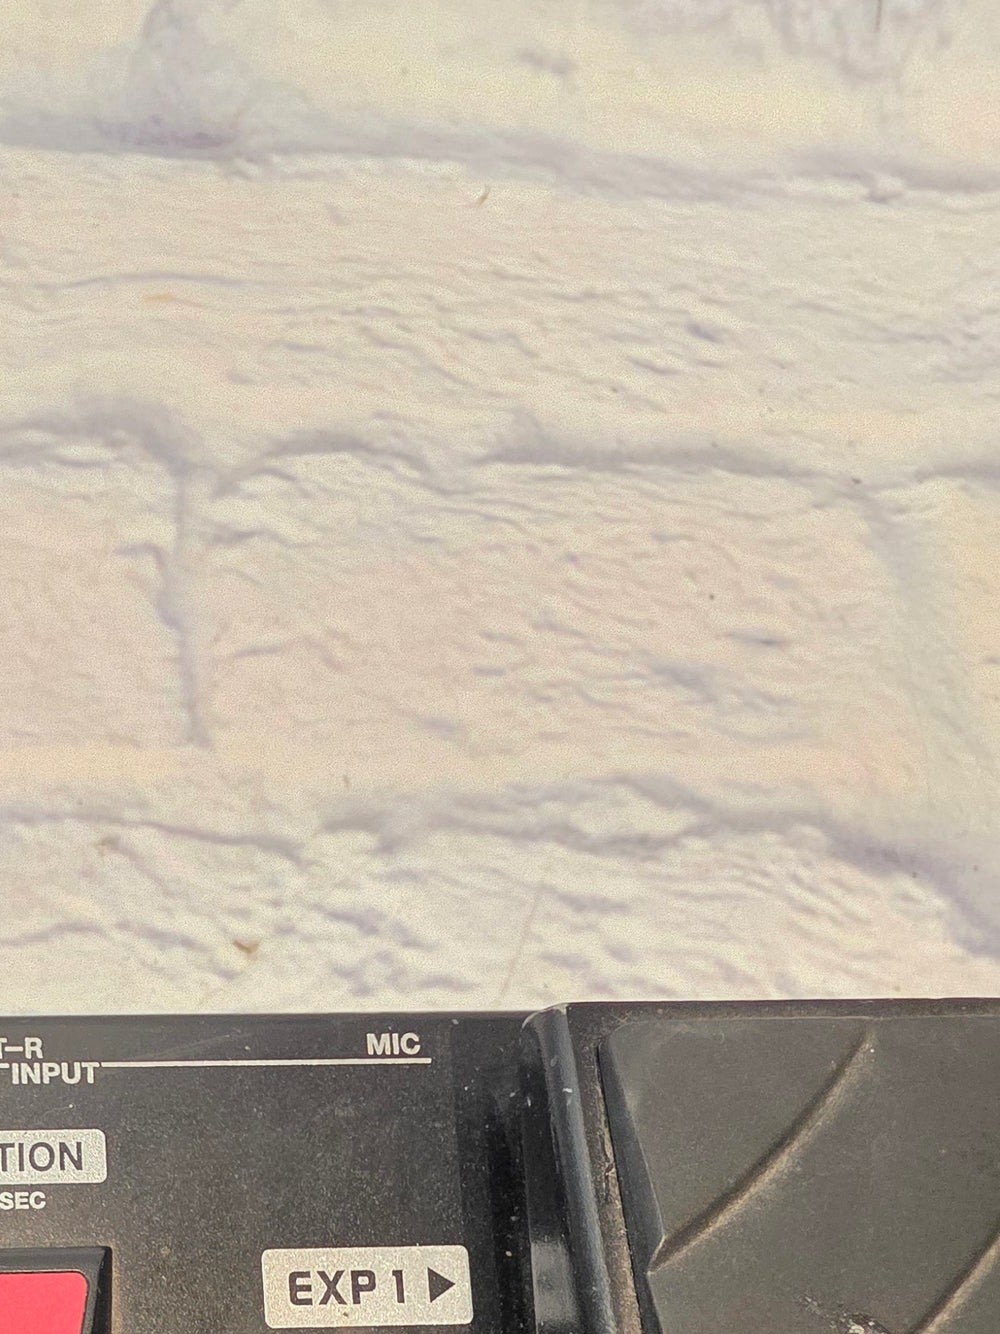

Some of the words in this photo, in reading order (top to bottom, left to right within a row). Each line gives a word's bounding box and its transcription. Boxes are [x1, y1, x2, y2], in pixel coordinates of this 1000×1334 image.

[366, 1033, 421, 1055] MIC
[10, 1062, 101, 1085] INPUT
[288, 1269, 376, 1306] EXP
[392, 1270, 404, 1303] 1
